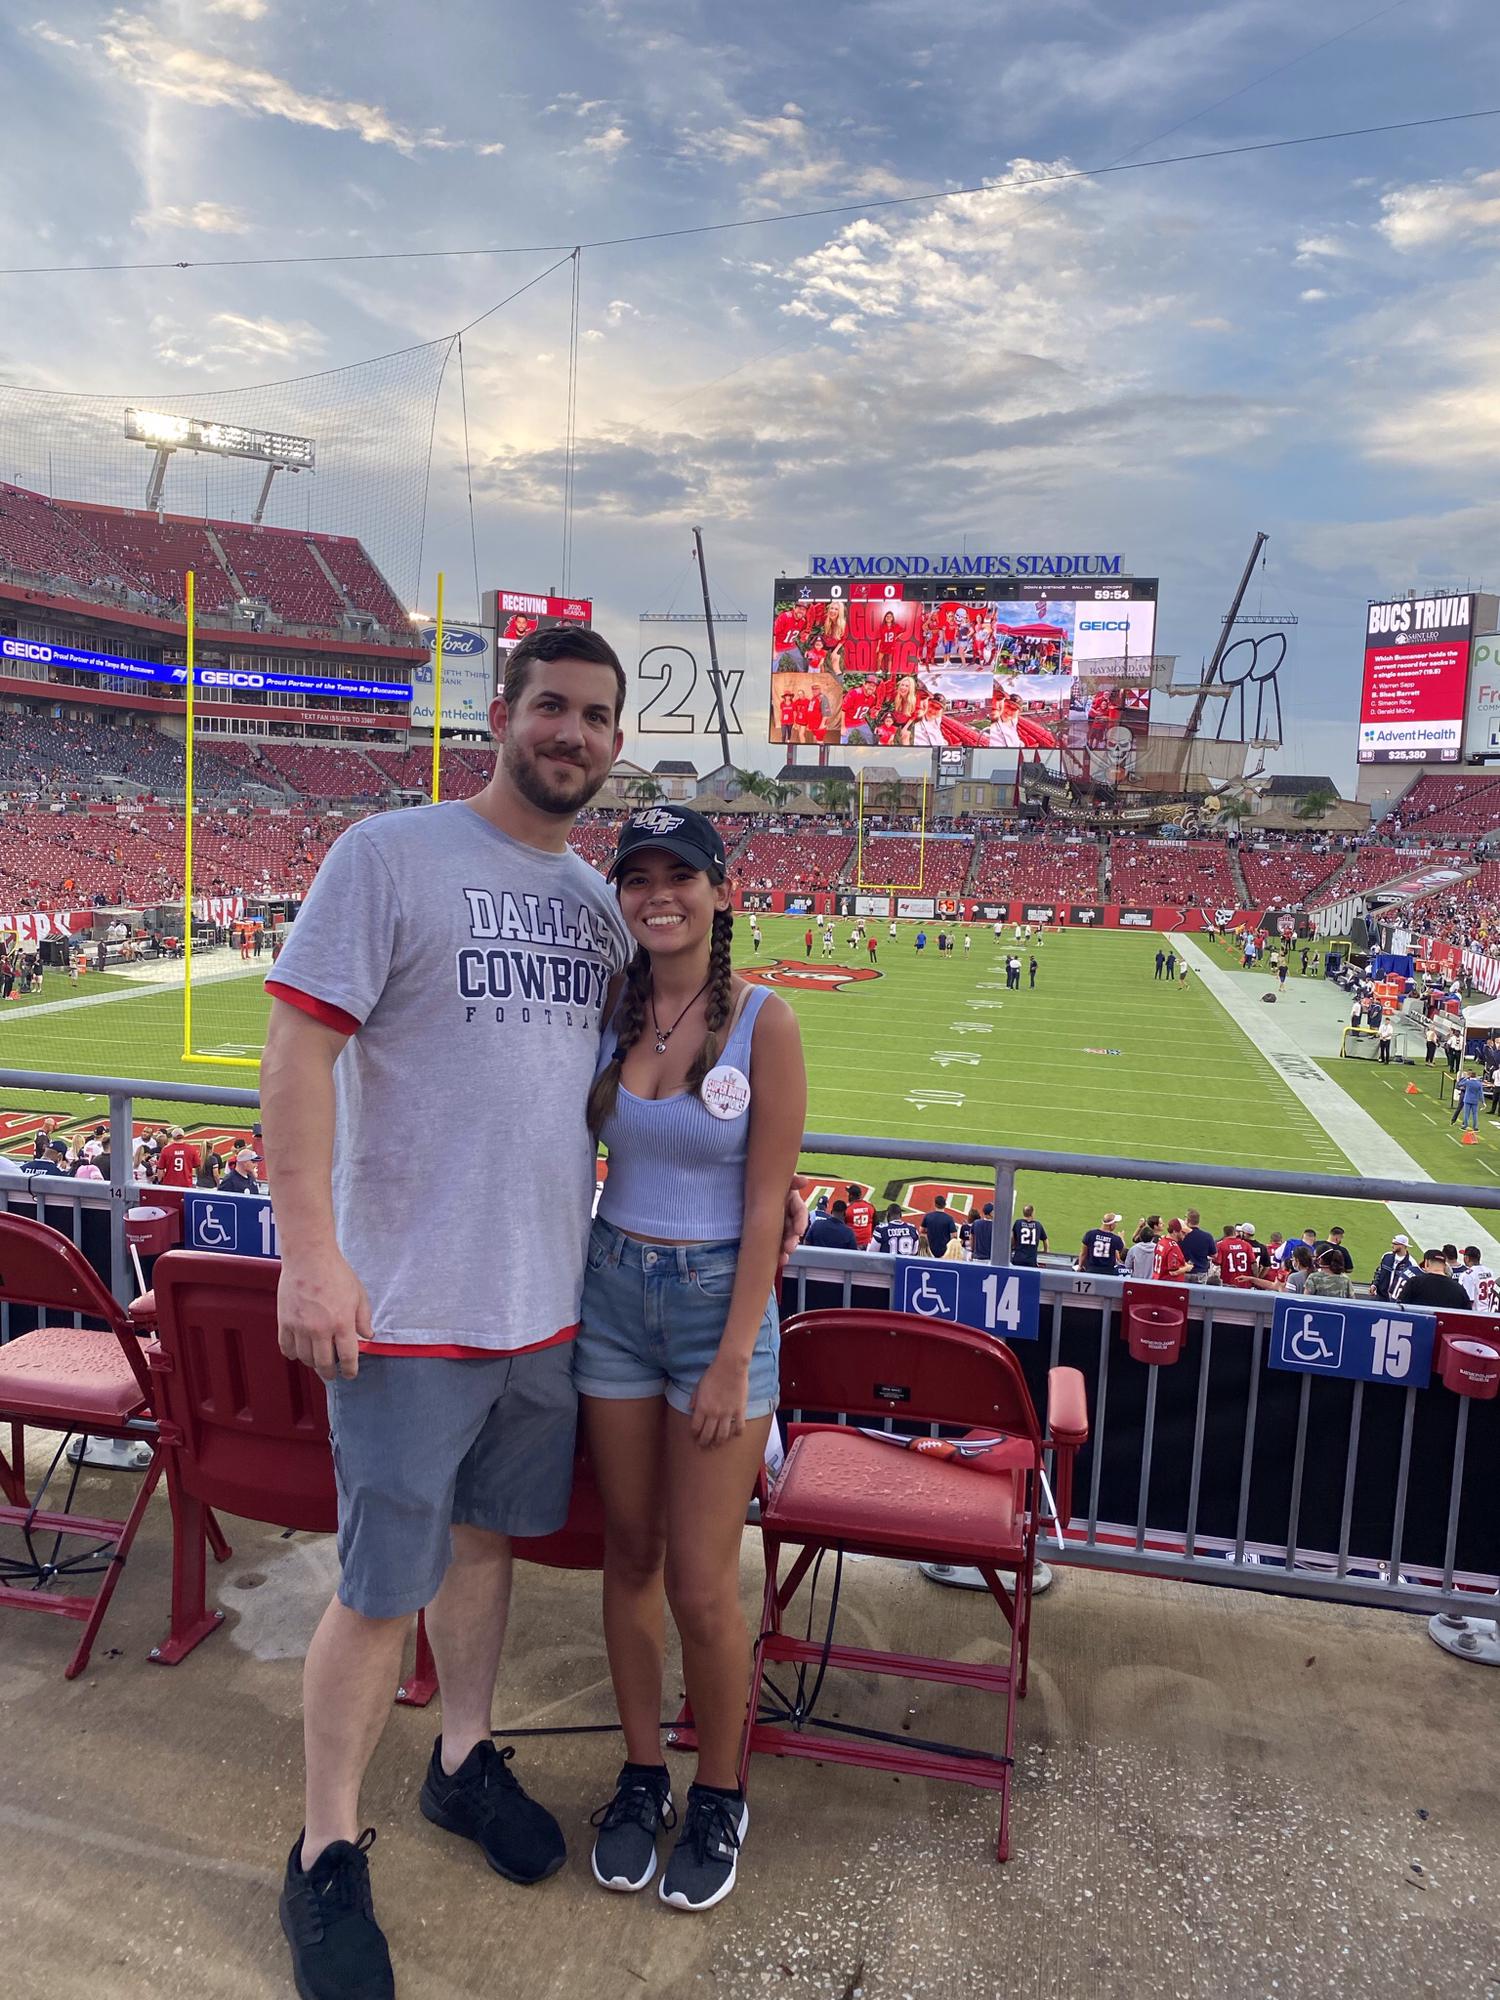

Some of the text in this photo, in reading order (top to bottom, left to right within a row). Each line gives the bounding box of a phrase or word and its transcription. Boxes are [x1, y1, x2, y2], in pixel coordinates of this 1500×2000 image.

[811, 555, 1122, 577] RAYMOND JAMES STADIUM
[830, 585, 842, 598] 0
[883, 585, 896, 598] 0
[1094, 590, 1130, 600] 59:54
[502, 594, 548, 614] RECEIVING
[1368, 596, 1470, 634] BUCS TRIVIA
[1079, 621, 1131, 632] GEICO
[430, 631, 474, 653] Ford
[783, 629, 800, 644] 12
[883, 631, 895, 644] 12
[3, 640, 52, 662] GEICO
[53, 651, 69, 661] Proud
[69, 654, 89, 664] Partner
[89, 657, 96, 665] of
[104, 660, 120, 670] Tampa
[120, 663, 129, 672] Bay
[129, 665, 155, 675] Buccaneers
[464, 671, 490, 680] THIRD
[1089, 664, 1135, 675] RAYMOND
[201, 670, 265, 688] GEICO
[266, 678, 287, 687] Proud
[288, 680, 315, 689] Partner
[337, 684, 358, 693] Tampa
[359, 686, 371, 694] Bay
[372, 687, 409, 696] Buccaneers
[638, 645, 745, 735] 2x
[301, 712, 316, 720] TEXT
[330, 714, 351, 723] ISSUES
[413, 704, 488, 722] AdvntHealth
[852, 706, 870, 720] 12
[942, 750, 961, 762] 25
[632, 807, 686, 834] UCF
[463, 887, 616, 960] DALLAS
[456, 946, 609, 1011] COWBOY
[465, 1006, 600, 1029] FOOTBA
[707, 1078, 728, 1095] SUPER
[704, 1090, 745, 1112] CHAMPIONS
[174, 1157, 184, 1172] 9
[109, 1187, 122, 1199] 14
[887, 1227, 910, 1237] COOPER
[1020, 1228, 1037, 1245] 21
[1093, 1241, 1111, 1258] 21
[1226, 1252, 1248, 1273] 13
[1075, 1280, 1092, 1293] 17
[982, 1274, 1021, 1331] 14
[1370, 1318, 1414, 1379] 15
